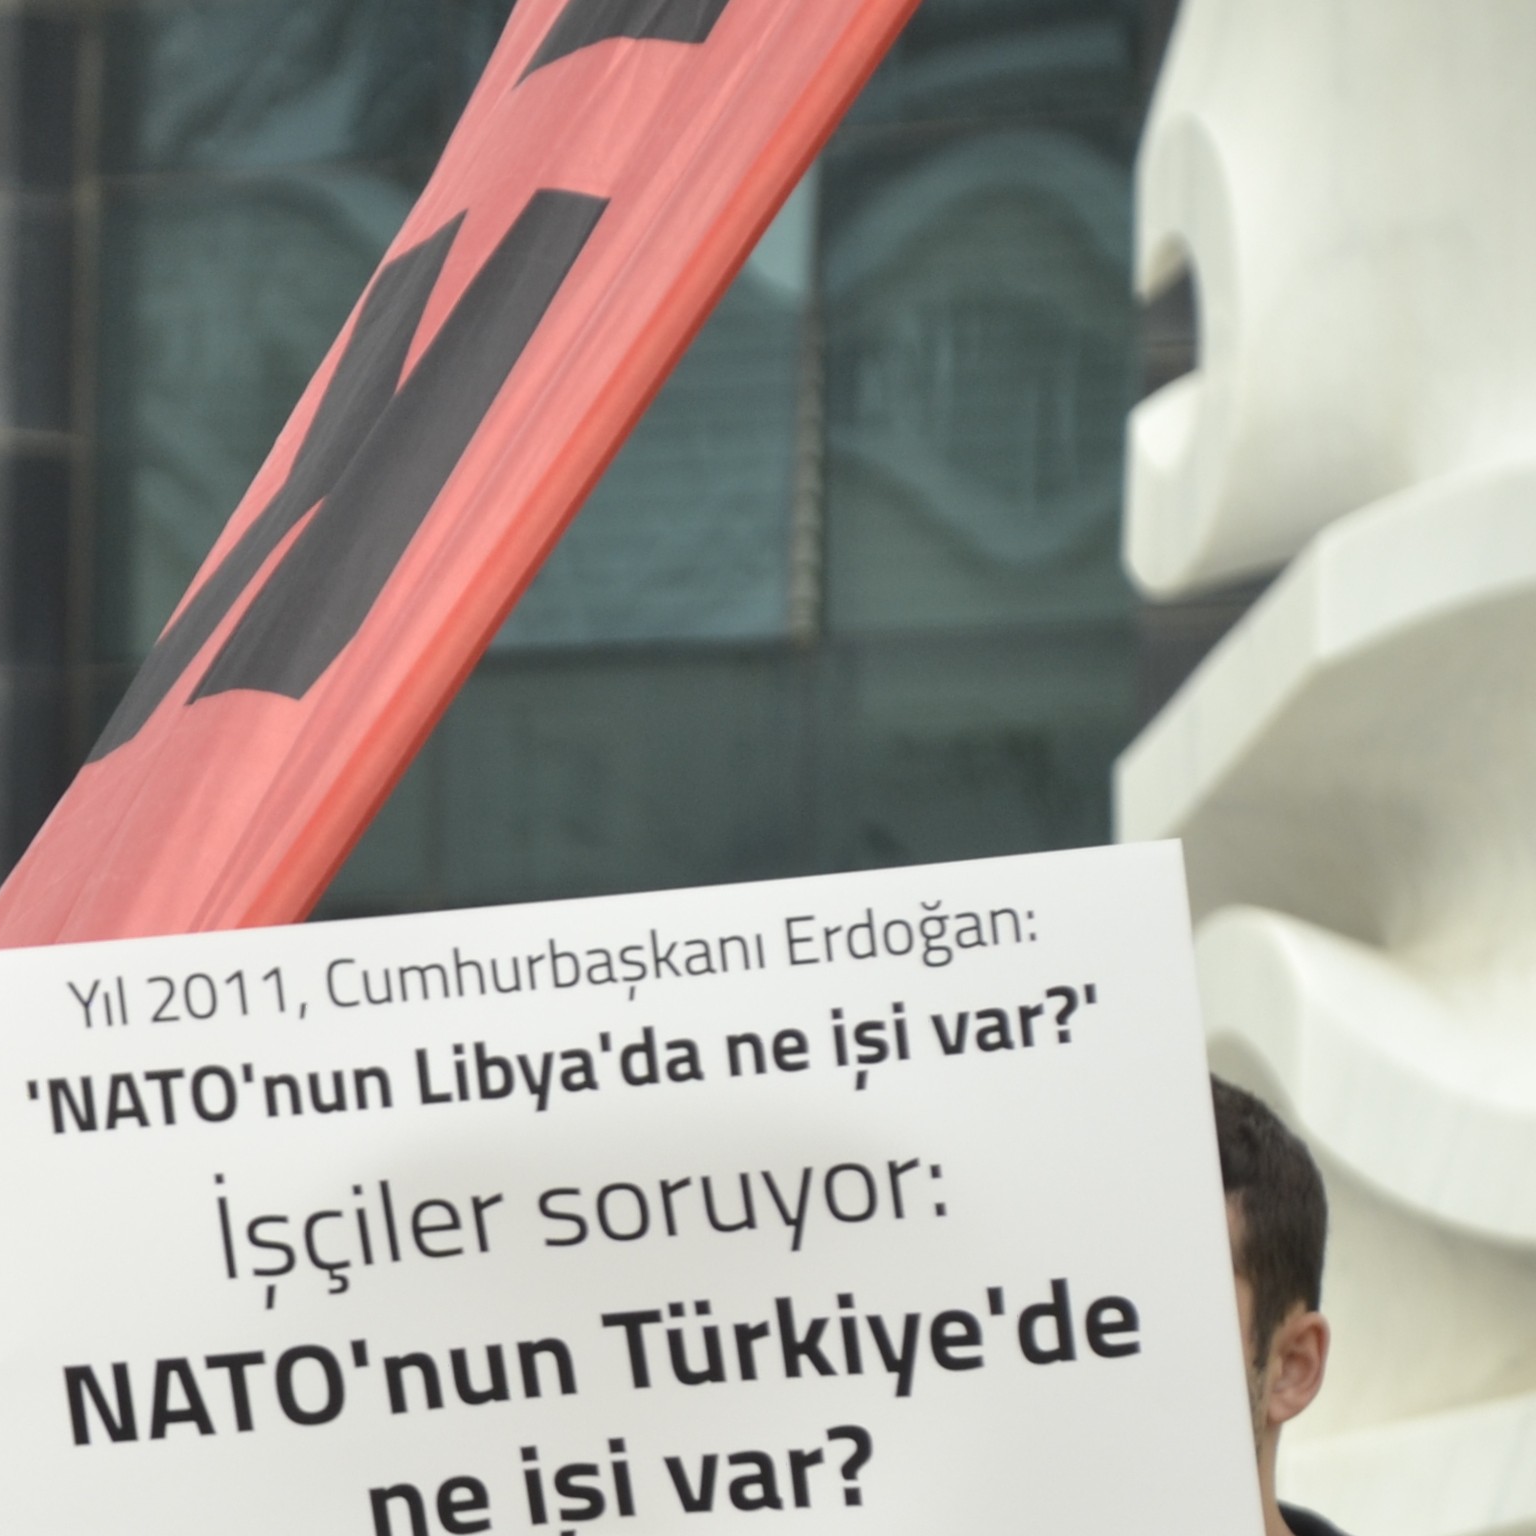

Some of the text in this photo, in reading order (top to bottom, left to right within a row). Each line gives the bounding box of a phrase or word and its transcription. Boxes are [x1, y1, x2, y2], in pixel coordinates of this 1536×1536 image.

[67, 901, 1040, 1029] Yıl 2011, Cumhurbaşkanı Erdoğan:
[26, 982, 1097, 1135] 'NATO'nun Libya'da ne işi var?'
[214, 1157, 947, 1309] İşçiler soruyor:
[62, 1277, 1142, 1447] NATO'nun Türkiye'de
[662, 1423, 874, 1515] var?
